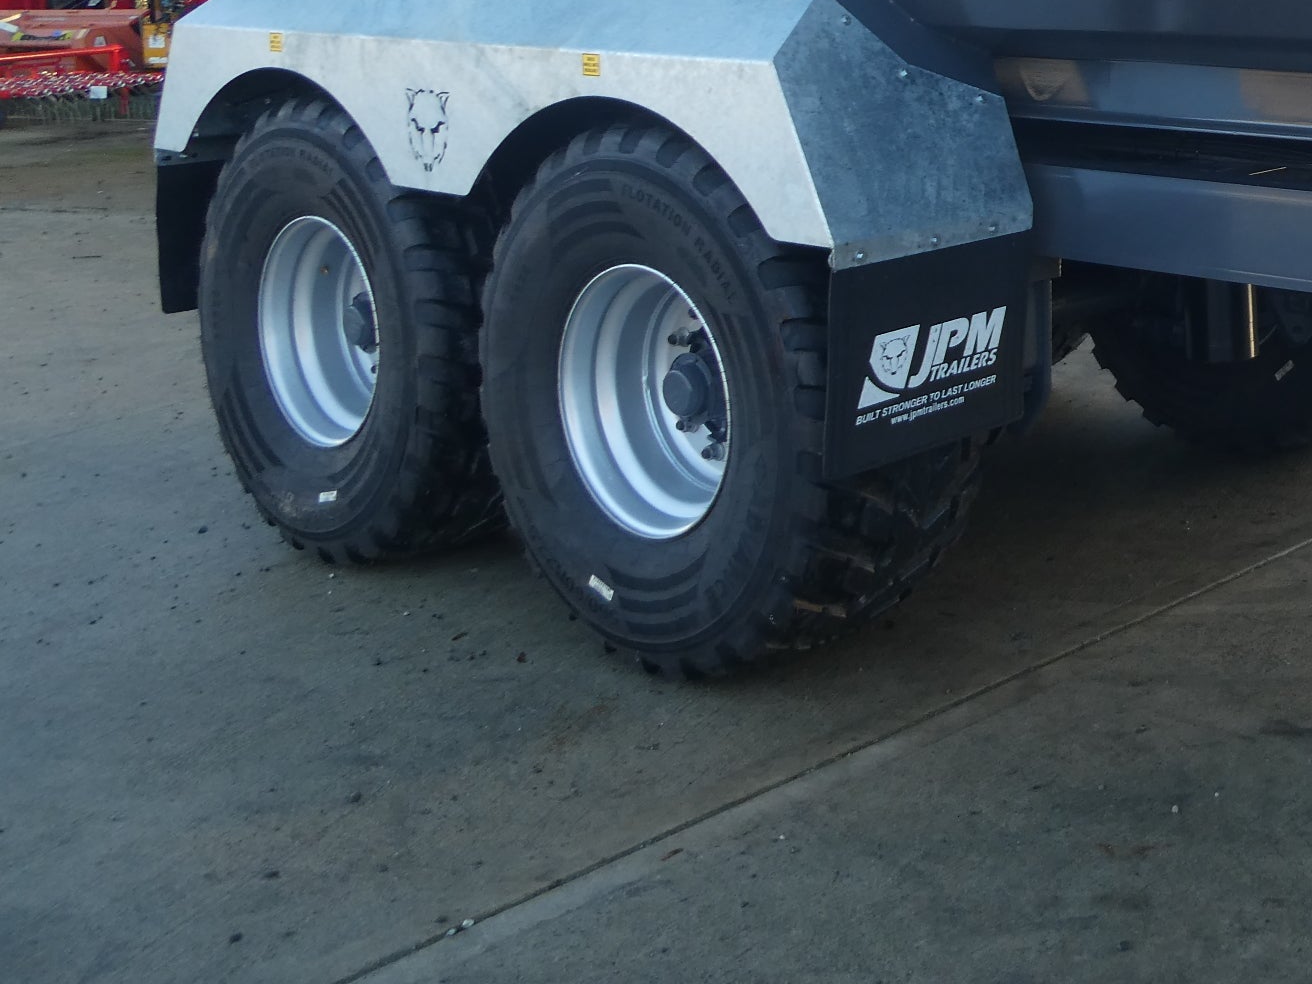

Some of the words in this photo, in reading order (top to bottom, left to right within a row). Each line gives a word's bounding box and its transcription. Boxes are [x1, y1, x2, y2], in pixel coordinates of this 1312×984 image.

[907, 305, 1007, 389] JPM
[930, 348, 998, 382] TRAILERS
[855, 409, 882, 426] BUILT
[882, 394, 929, 417] STRONGER
[929, 391, 941, 403] TO
[941, 385, 963, 399] LAST
[963, 374, 997, 392] LONGER
[890, 395, 965, 425] www.jpmtrailers.com
